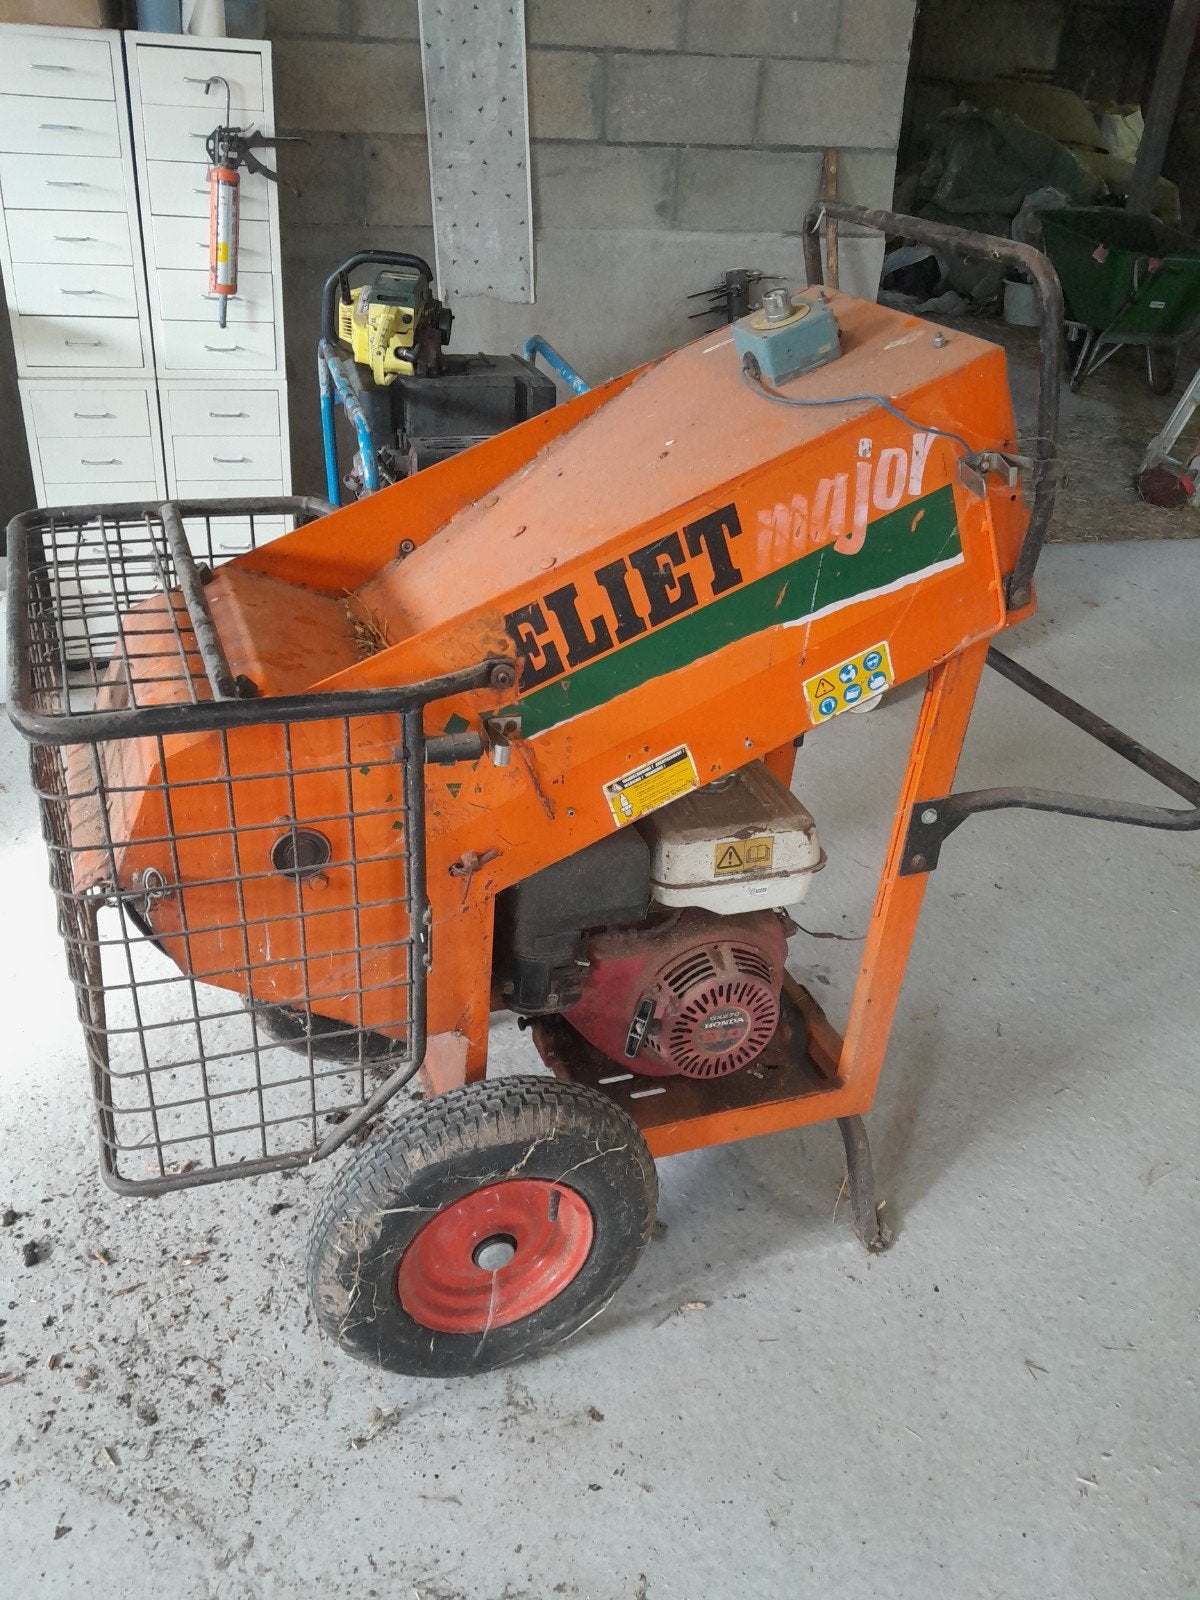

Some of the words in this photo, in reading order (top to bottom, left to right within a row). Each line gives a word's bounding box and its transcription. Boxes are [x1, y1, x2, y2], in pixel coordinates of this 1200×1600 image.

[504, 503, 743, 694] ELIET
[757, 427, 939, 570] major
[710, 1011, 740, 1021] GX270
[704, 1017, 745, 1029] HONDA
